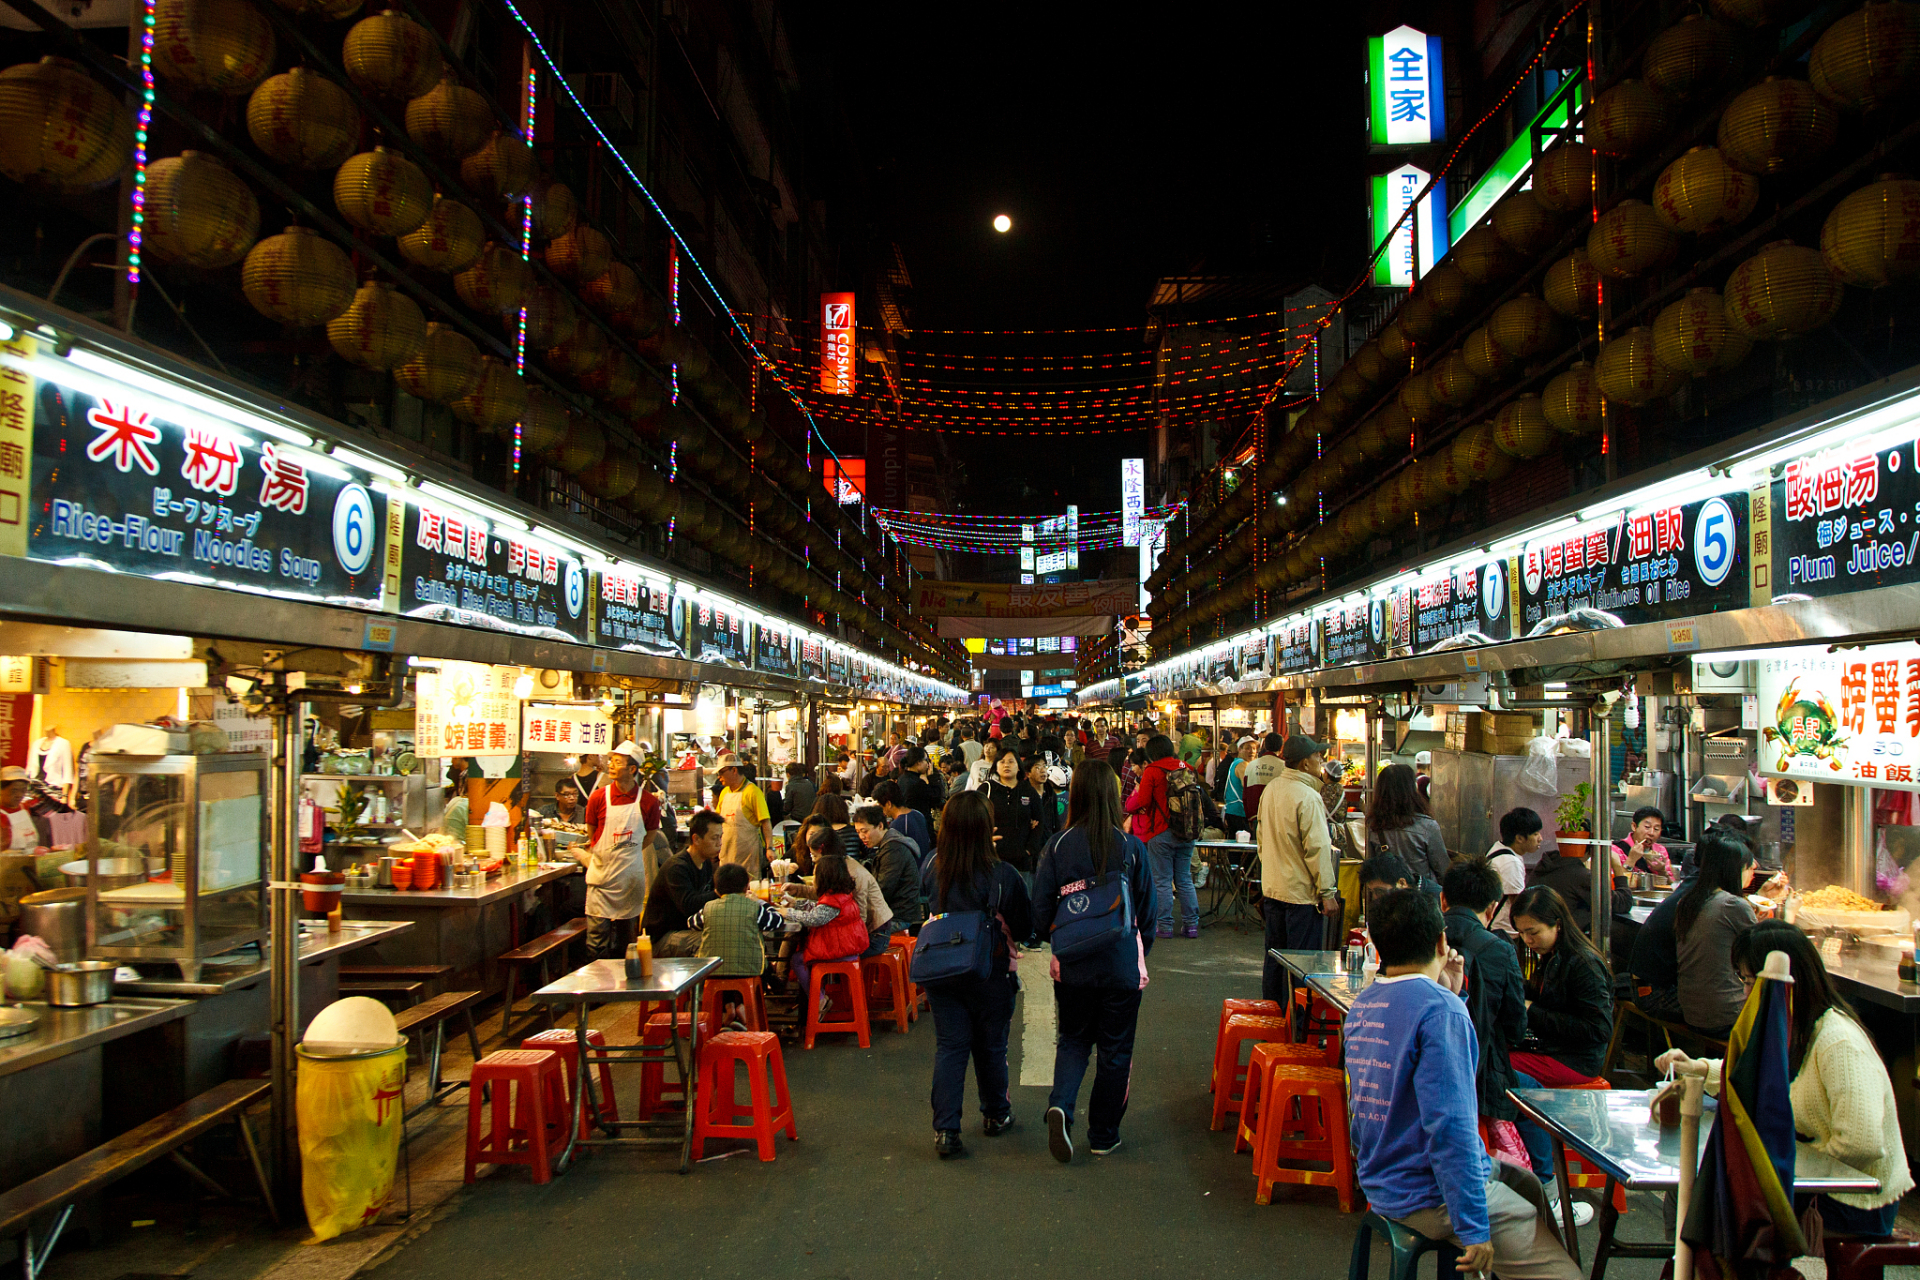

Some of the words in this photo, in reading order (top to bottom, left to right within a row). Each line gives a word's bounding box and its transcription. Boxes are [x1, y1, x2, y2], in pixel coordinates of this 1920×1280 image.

[1388, 47, 1426, 122] 全家
[1401, 174, 1418, 275] Famlyart
[87, 398, 310, 515] 米粉湯
[152, 486, 262, 537] ビーフンスープ
[345, 503, 364, 556] 6
[52, 498, 184, 556] Rice-Flour
[193, 529, 272, 573] Noodles
[279, 547, 321, 586] Soup
[1703, 514, 1726, 570] 5
[1789, 555, 1835, 585] Plum
[517, 600, 534, 623] Fish
[537, 605, 557, 628] Soup
[1009, 583, 1089, 608] 最友善
[1092, 592, 1134, 615] 夜市
[1526, 604, 1541, 623] Crab
[1646, 579, 1660, 605] Oil
[1666, 579, 1690, 602] Rice
[445, 722, 506, 750] 螃蟹羹
[530, 719, 572, 743] 螃蟹羹
[579, 722, 607, 745] 油飯
[1792, 716, 1821, 741] 吳記
[1852, 761, 1913, 782] 油飯
[1372, 1058, 1392, 1070] Trade
